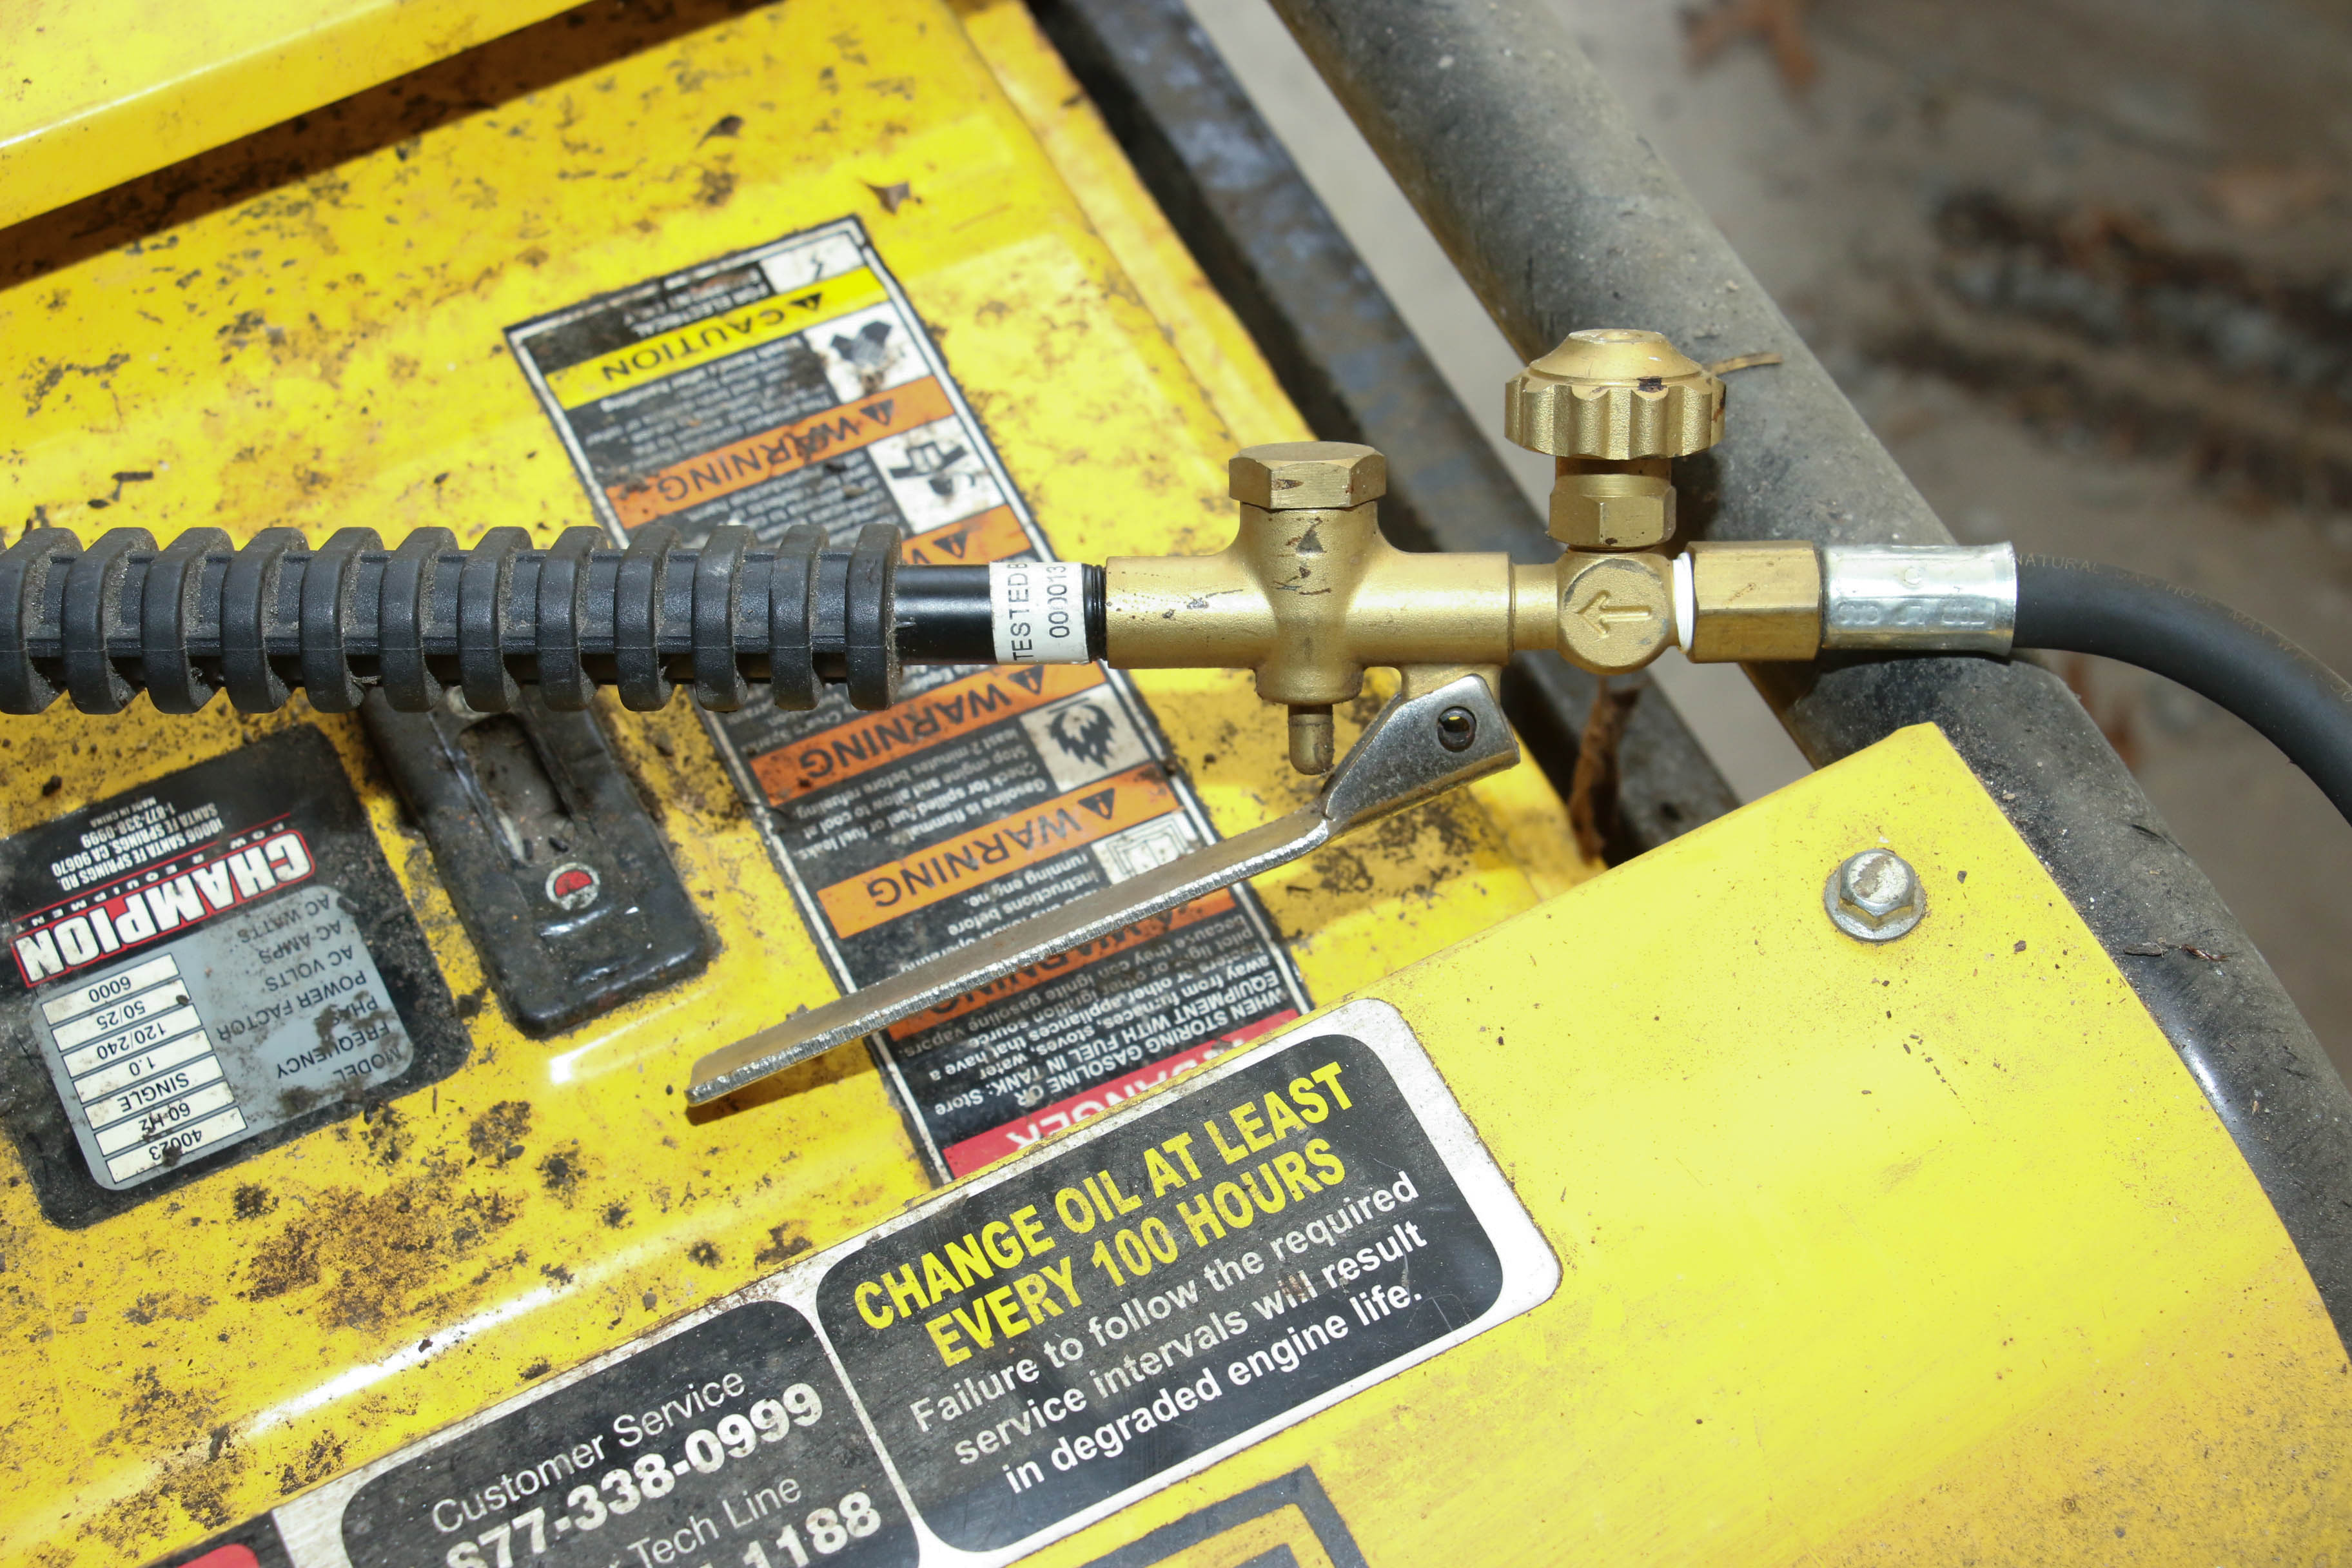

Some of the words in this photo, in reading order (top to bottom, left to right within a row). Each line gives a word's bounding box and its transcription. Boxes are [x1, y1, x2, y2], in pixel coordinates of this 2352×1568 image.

[599, 306, 787, 381] CAUTION
[653, 413, 861, 503] WARNING
[2012, 553, 2099, 574] NATURAL
[1008, 573, 1034, 661] TESTED
[794, 680, 1012, 781] WARNING
[870, 787, 913, 813] allow
[910, 776, 943, 798] and
[965, 778, 992, 797] for
[79, 800, 177, 849] 1-877-338-0999
[88, 810, 119, 828] CHINA
[118, 806, 131, 818] IN
[162, 817, 180, 834] FE
[177, 801, 219, 828] SANTA
[818, 810, 855, 834] cool
[144, 832, 187, 859] SANTA
[183, 817, 225, 843] 10006
[190, 821, 286, 865] POWR
[836, 825, 869, 847] fuel
[50, 850, 92, 877] 90670
[77, 852, 133, 885] SPRINGS
[89, 843, 111, 862] CA
[131, 847, 148, 864] FE
[863, 805, 1082, 911] WARNING
[1022, 848, 1090, 887] running
[14, 863, 178, 934] EQUIPMENT
[56, 873, 80, 893] RD.
[961, 874, 1024, 909] engne.
[1001, 868, 1099, 916] instructions
[13, 830, 315, 983] CHAMPION
[303, 894, 332, 917] AC
[235, 907, 302, 944] WATTS
[315, 919, 344, 941] AC
[945, 906, 1003, 939] before
[1212, 924, 1255, 950] pilot
[257, 932, 314, 965] AMPS
[326, 944, 357, 967] AC
[263, 957, 326, 993] VOLTS
[1148, 960, 1170, 976] or
[1222, 952, 1271, 981] away
[86, 975, 133, 1003] 6000
[295, 969, 368, 1009] POWER
[1042, 970, 1097, 1004] ignite
[1124, 975, 1175, 1004] other
[1168, 968, 1281, 1025] EQUIPMENT
[1180, 973, 1226, 1001] from
[1228, 986, 1286, 1020] WHEN
[95, 999, 147, 1031] 50/25
[215, 999, 293, 1041] FACTOR
[963, 991, 1044, 1035] gasoline
[1026, 994, 1124, 1044] appliances
[1119, 1012, 1171, 1044] WITH
[94, 1021, 166, 1061] 120/240
[990, 1035, 1028, 1059] that
[1028, 1023, 1096, 1059] stoves,
[1144, 1009, 1230, 1054] STORING
[127, 1054, 156, 1077] 1.0
[271, 1019, 391, 1079] FREQUENCY
[331, 1045, 404, 1085] MODEL
[943, 1050, 990, 1077] have
[1044, 1053, 1069, 1075] IN
[1066, 1033, 1120, 1066] FUEL
[928, 1068, 943, 1083] a
[976, 1051, 1028, 1081] water
[984, 1063, 1044, 1099] TANK:
[1045, 1043, 1145, 1095] GASOLINE
[116, 1071, 190, 1112] SINGLE
[932, 1086, 985, 1120] Store
[1012, 1084, 1046, 1108] OR
[137, 1112, 165, 1133] Hz
[166, 1100, 192, 1122] 60
[854, 1204, 1056, 1330] CHANGE
[1055, 1170, 1144, 1234] OIL
[1143, 1132, 1202, 1199] AT
[1206, 1061, 1353, 1165] LEAST
[925, 1255, 1083, 1367] EVERY
[1091, 1217, 1179, 1287] 100
[1178, 1138, 1346, 1248] HOURS
[909, 1358, 1039, 1433] Failure
[1043, 1337, 1084, 1368] to
[1088, 1279, 1199, 1348] follow
[1203, 1251, 1264, 1291] the
[1269, 1170, 1419, 1262] required
[955, 1388, 1087, 1465] service
[1089, 1311, 1248, 1398] intervals
[1253, 1269, 1318, 1320] will
[1322, 1220, 1427, 1289] result
[1006, 1461, 1045, 1494] in
[1051, 1367, 1222, 1471] degraded
[1228, 1315, 1349, 1386] engine
[1349, 1284, 1422, 1326] life.
[432, 1435, 605, 1533] Customer
[613, 1373, 745, 1447] Service
[627, 1515, 720, 1568] Tech
[721, 1478, 801, 1529] Line
